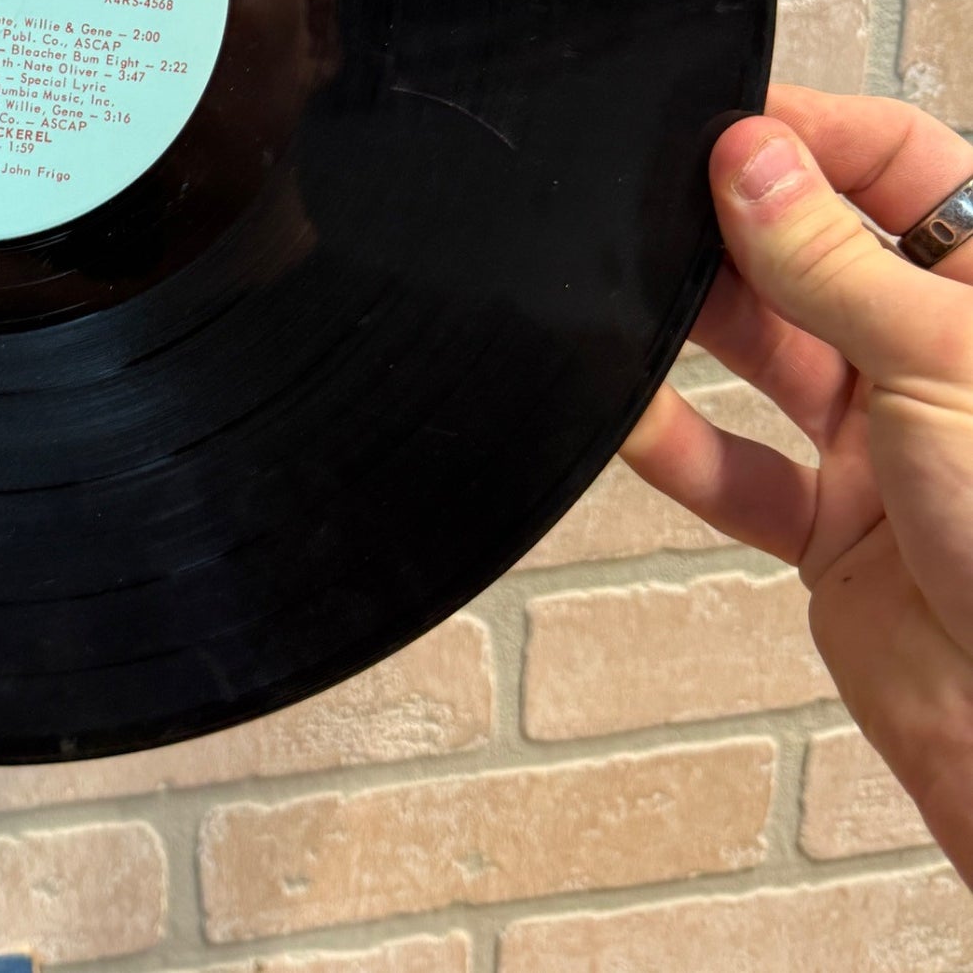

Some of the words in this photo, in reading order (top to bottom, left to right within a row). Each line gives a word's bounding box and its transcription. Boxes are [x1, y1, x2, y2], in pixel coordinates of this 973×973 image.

[3, 28, 36, 42] Publ.
[74, 37, 122, 51] ASCAP
[24, 17, 61, 31] Willie
[65, 22, 75, 33] &
[81, 23, 113, 37] Gene
[132, 29, 161, 42] 2:00
[11, 44, 68, 59] Bleacher
[73, 50, 100, 64] Bum
[106, 54, 140, 69] Eight
[160, 60, 188, 73] 2:22
[20, 72, 67, 87] Special
[73, 78, 107, 92] Lyric
[58, 62, 99, 77] Oliver
[118, 69, 146, 82] 3:47
[42, 90, 84, 105] Music,
[91, 94, 115, 107] Inc.
[0, 112, 20, 124] Co.
[40, 117, 88, 131] ASCAP
[6, 99, 46, 115] Willie,
[52, 104, 84, 118] Gene
[104, 110, 131, 124] 3:16
[10, 141, 35, 153] 1:59
[1, 163, 31, 176] John
[37, 166, 71, 182] Frigo
